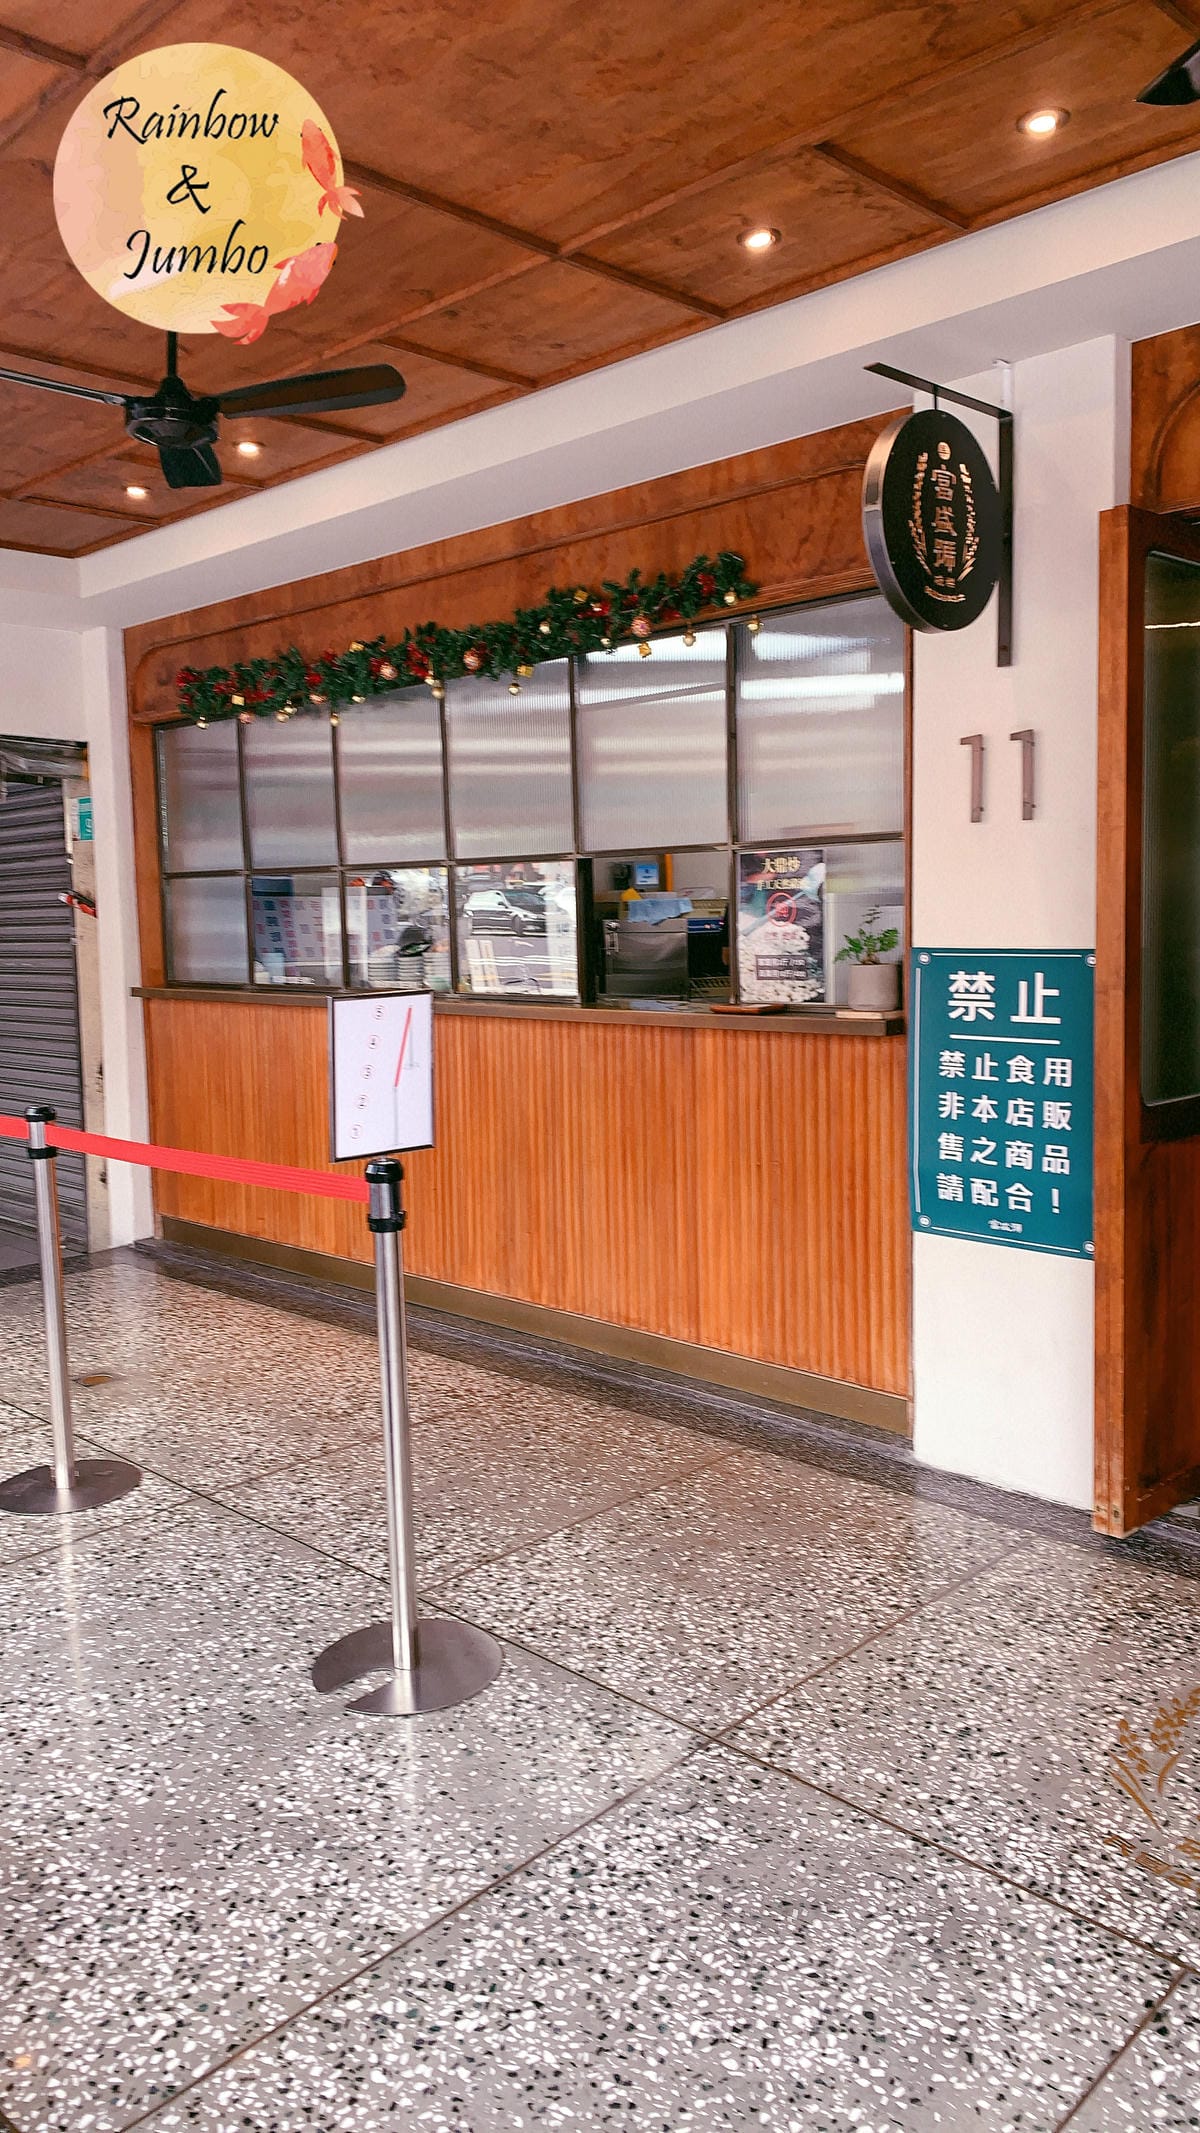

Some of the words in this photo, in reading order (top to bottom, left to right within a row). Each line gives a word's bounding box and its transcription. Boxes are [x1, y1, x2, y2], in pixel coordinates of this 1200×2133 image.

[960, 729, 1035, 823] 11
[948, 971, 1061, 1025] 禁止
[938, 1050, 1073, 1088] 禁止食用
[938, 1092, 1072, 1131] 非本店販
[937, 1133, 1070, 1175] 售之商品
